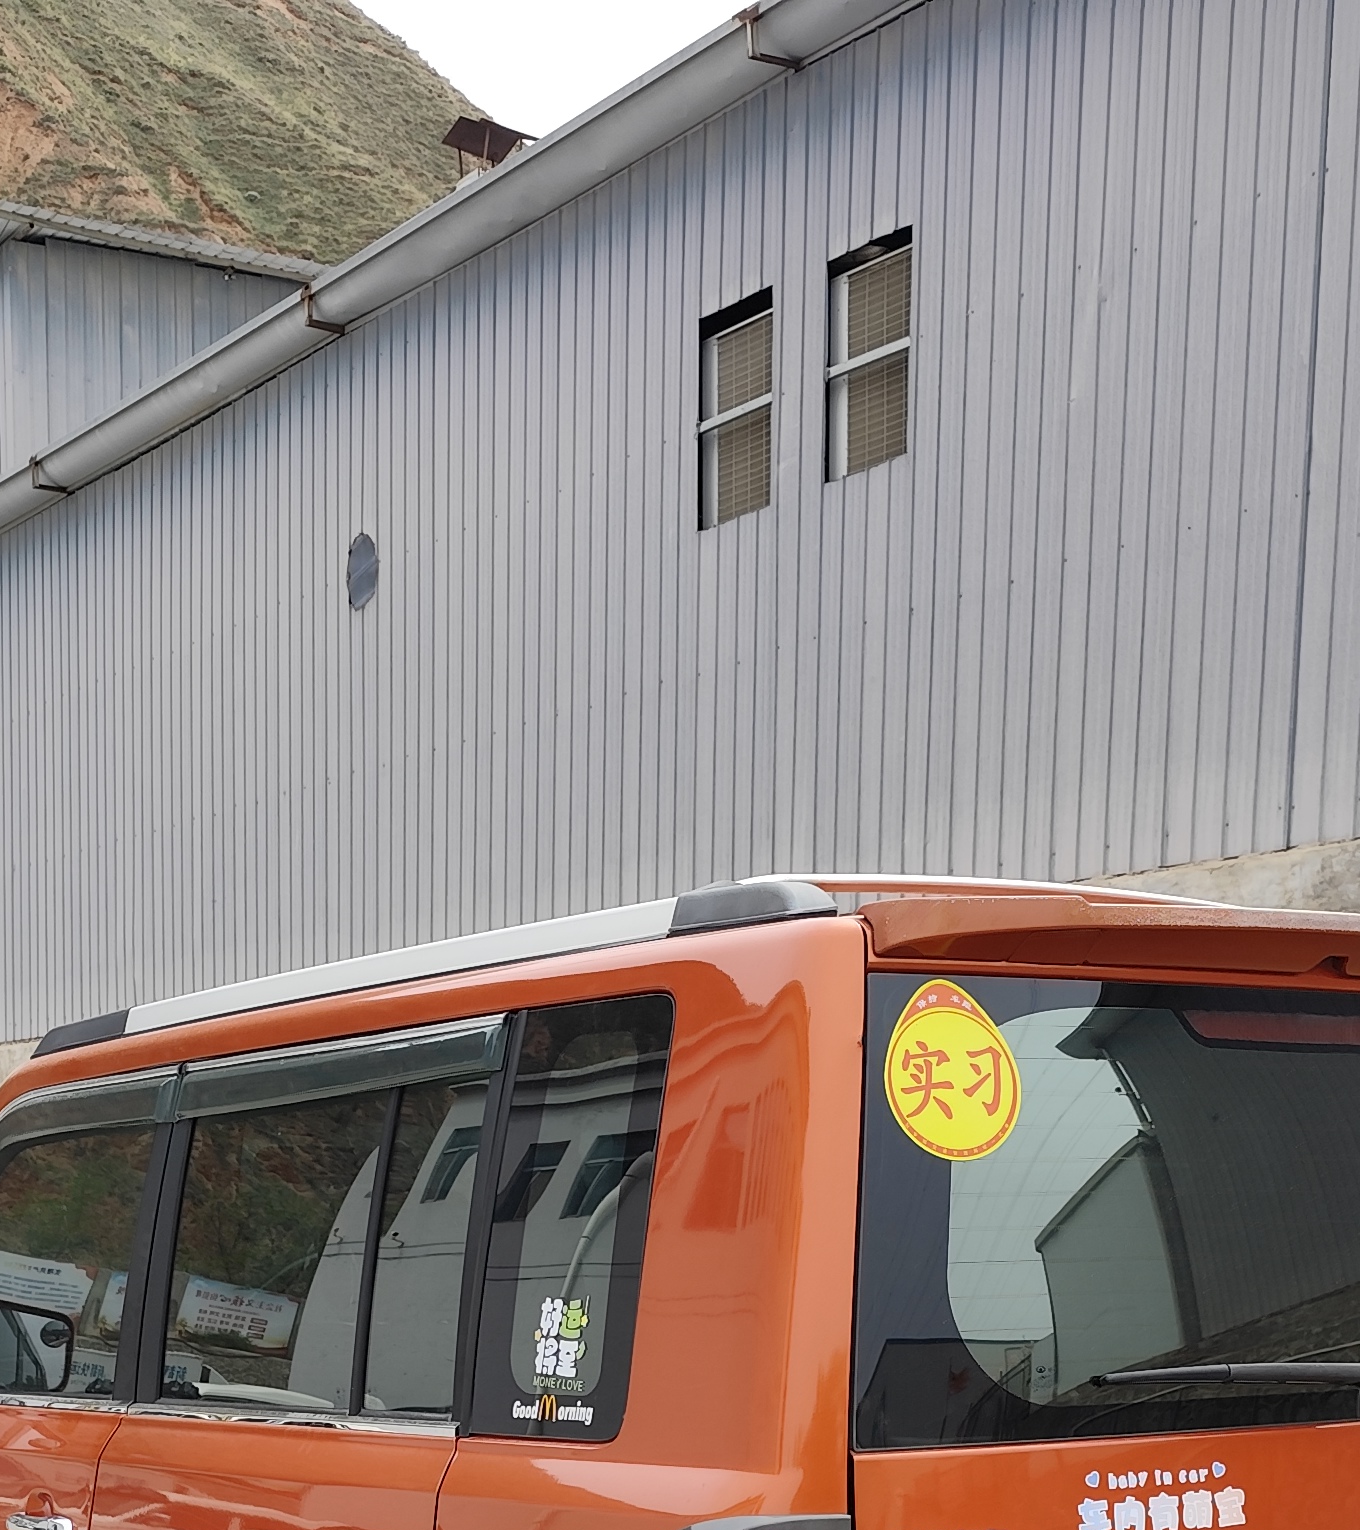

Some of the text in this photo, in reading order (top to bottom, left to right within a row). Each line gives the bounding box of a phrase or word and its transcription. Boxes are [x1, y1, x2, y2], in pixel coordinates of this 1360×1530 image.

[901, 1041, 1002, 1120] 实习
[533, 1376, 584, 1392] MONEY LOVE
[512, 1400, 540, 1420] Good
[1107, 1471, 1149, 1490] baby
